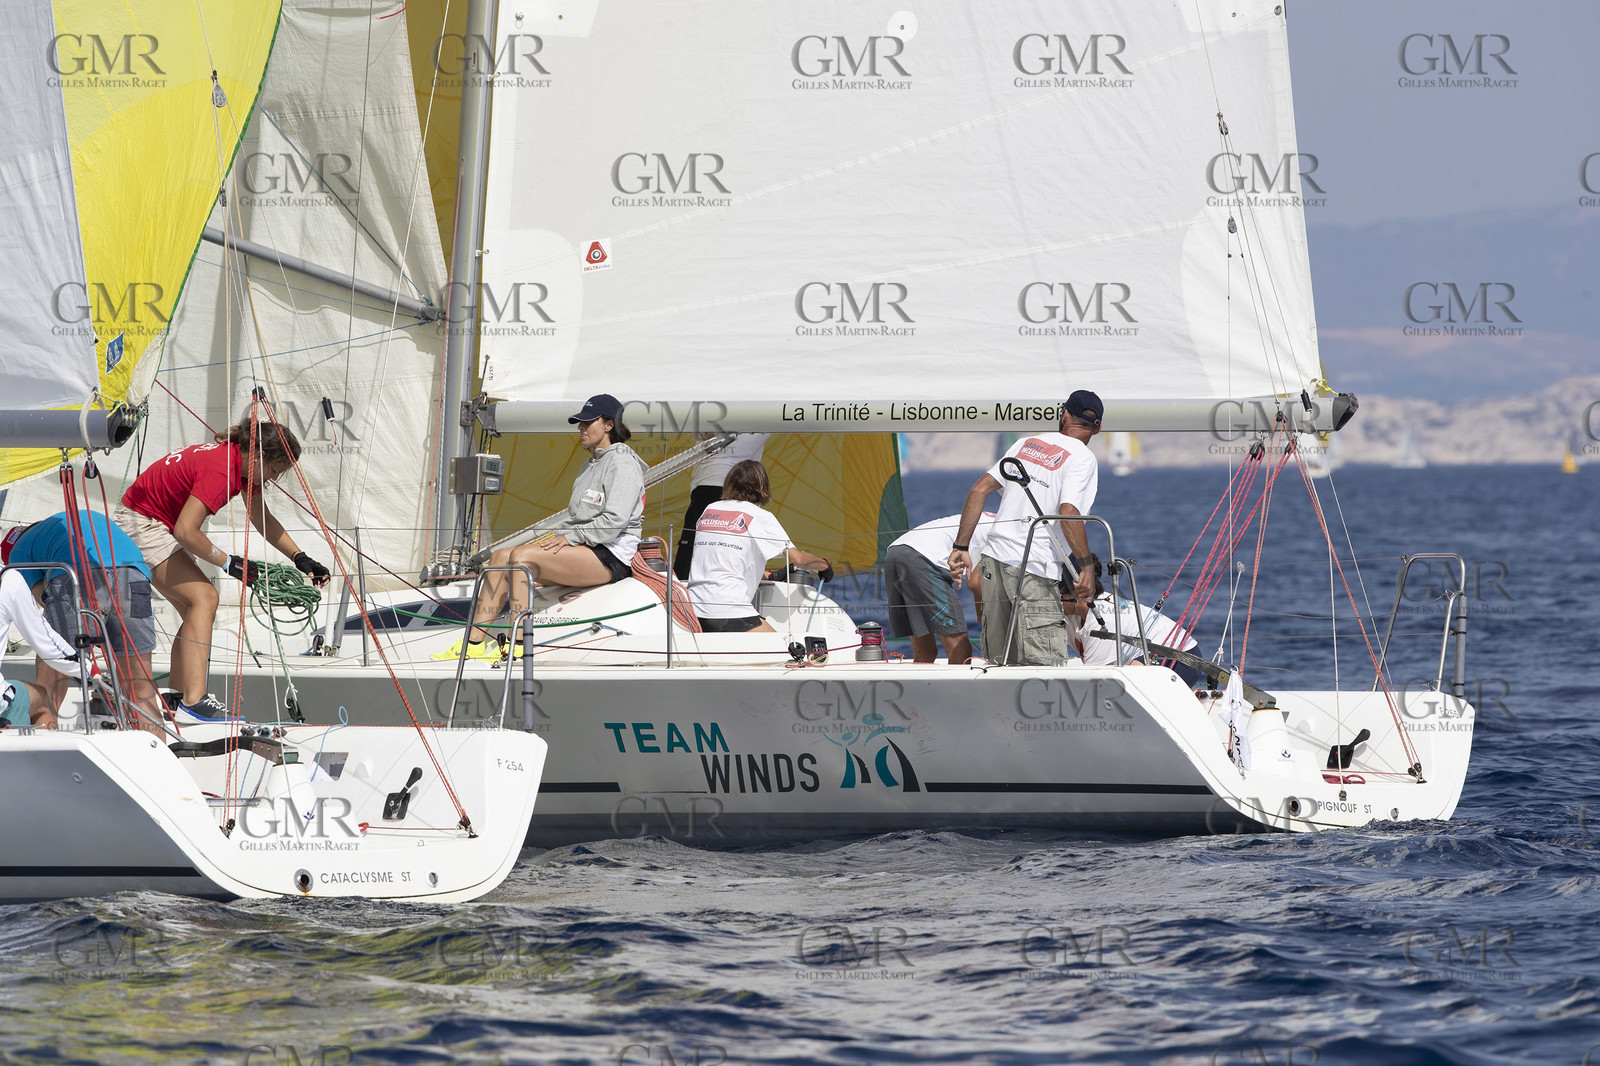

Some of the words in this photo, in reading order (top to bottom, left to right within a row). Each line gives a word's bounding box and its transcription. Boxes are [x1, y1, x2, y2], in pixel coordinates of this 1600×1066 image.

[782, 403, 805, 421] La
[812, 402, 870, 421] Trinité
[890, 402, 978, 421] Lisbonne
[994, 402, 1065, 421] Marsei
[604, 723, 730, 753] TEAM
[496, 758, 503, 768] F
[505, 759, 524, 772] 254
[700, 753, 820, 793] WINDS
[1318, 801, 1358, 813] PIGNOUF
[1364, 804, 1372, 814] ST
[320, 871, 394, 884] CATACLYSME
[401, 871, 411, 882] ST
